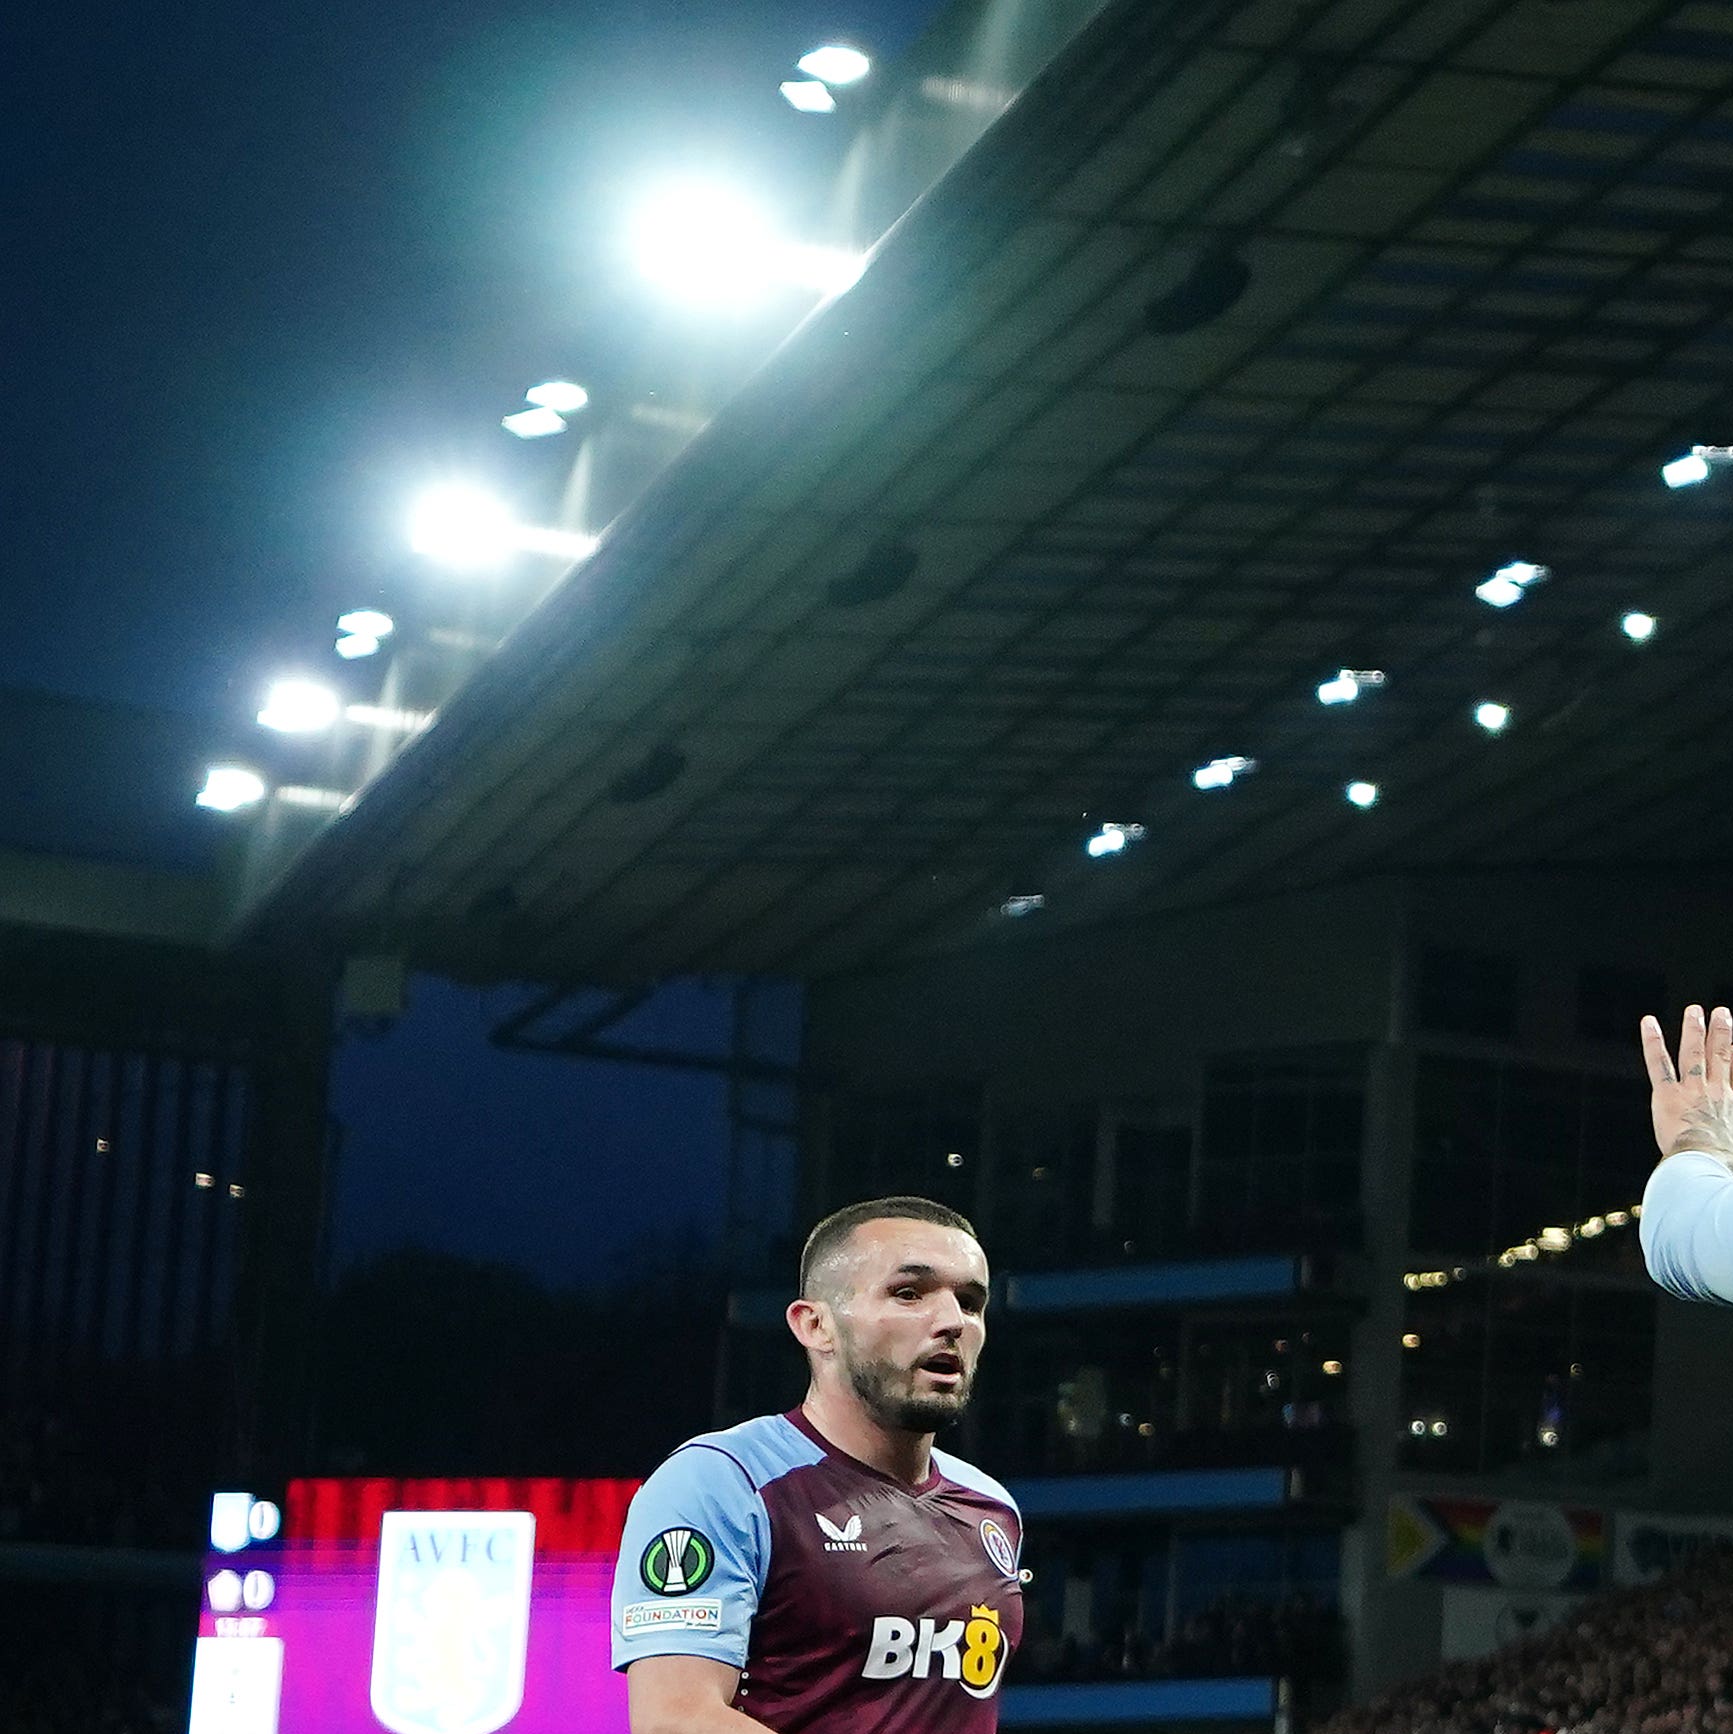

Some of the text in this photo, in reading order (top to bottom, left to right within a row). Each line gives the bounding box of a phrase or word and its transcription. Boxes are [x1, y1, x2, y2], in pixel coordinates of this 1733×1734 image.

[249, 1500, 281, 1541] 0
[400, 1532, 512, 1564] AVFC
[243, 1569, 276, 1611] 0
[625, 1609, 719, 1626] FOUNDATION
[862, 1615, 1001, 1687] BK8
